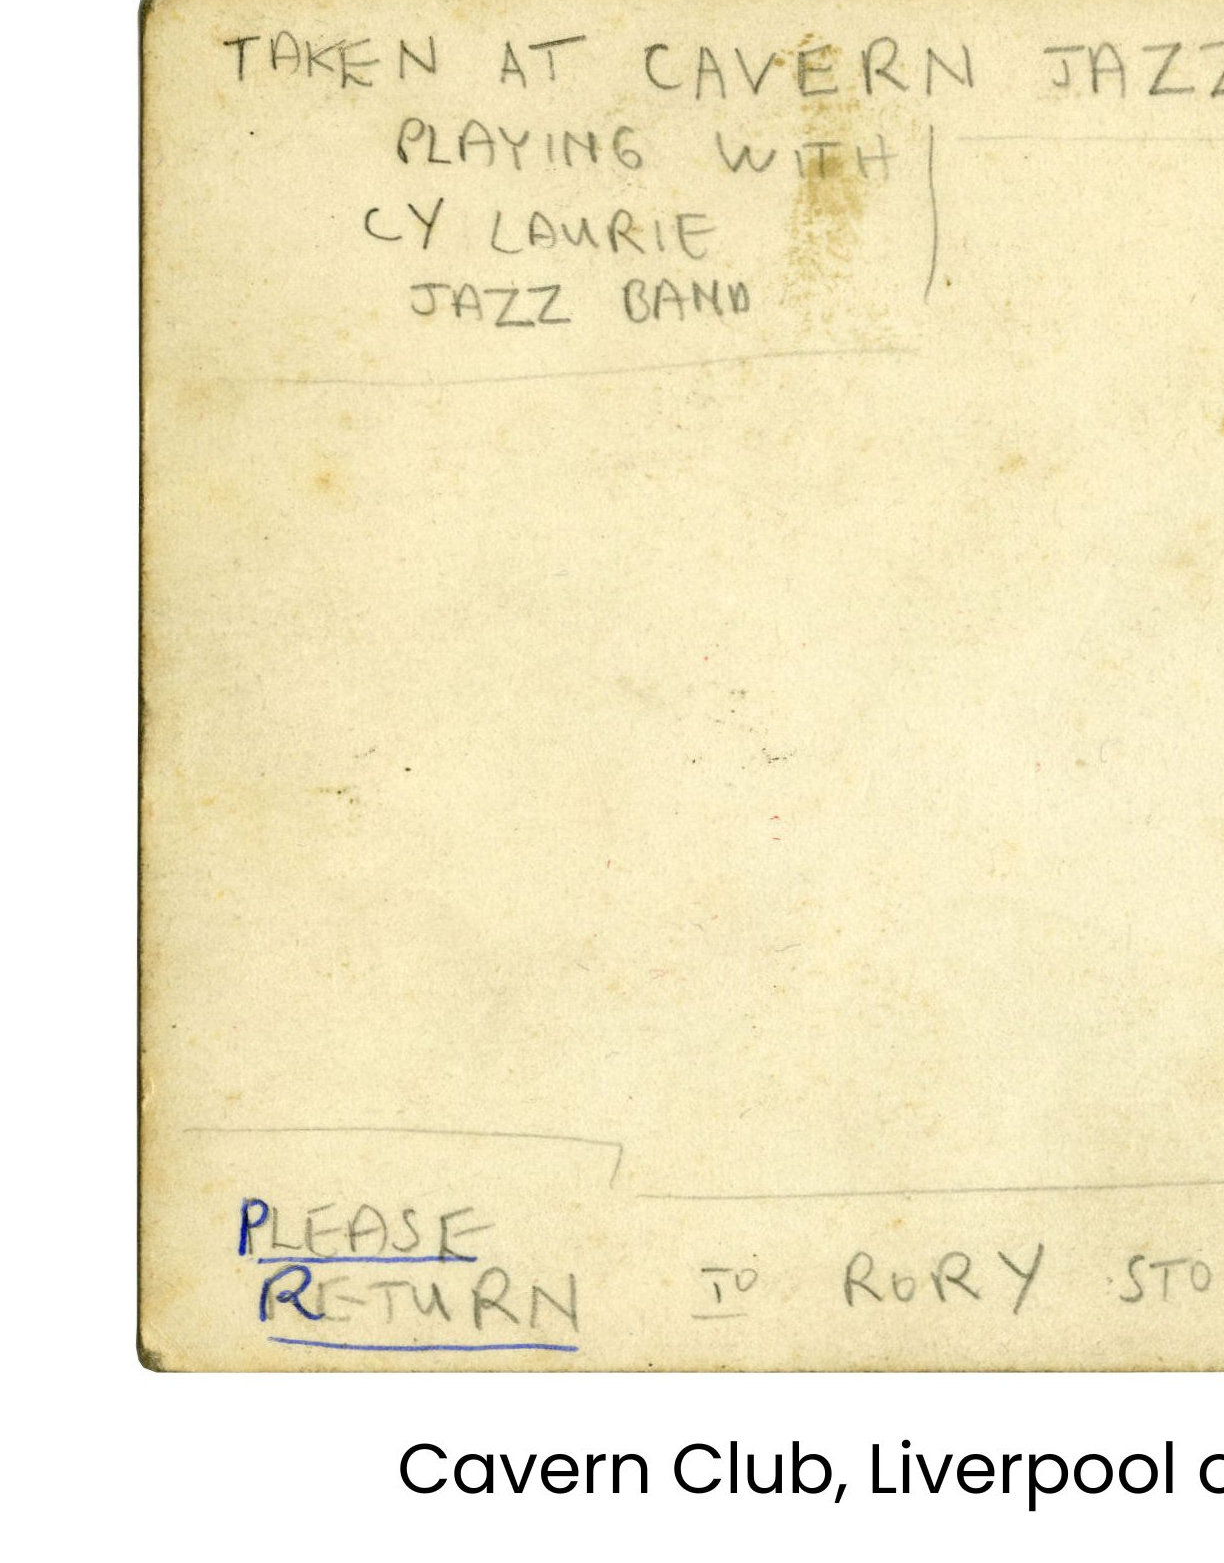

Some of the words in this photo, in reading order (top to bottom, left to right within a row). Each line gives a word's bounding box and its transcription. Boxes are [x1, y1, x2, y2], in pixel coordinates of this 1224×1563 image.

[222, 30, 438, 90] TAKEN
[500, 34, 587, 88] AT
[643, 33, 974, 101] CAVERN
[396, 116, 644, 171] PLAYING
[715, 131, 898, 182] WITH
[363, 197, 445, 251] CY
[490, 208, 715, 260] LAURIE
[410, 282, 572, 328] JAZZ
[621, 278, 750, 324] BAND
[237, 1197, 494, 1259] PLEASE
[258, 1262, 579, 1333] RETURN
[700, 1266, 759, 1304] TO
[843, 1247, 1044, 1316] RORY
